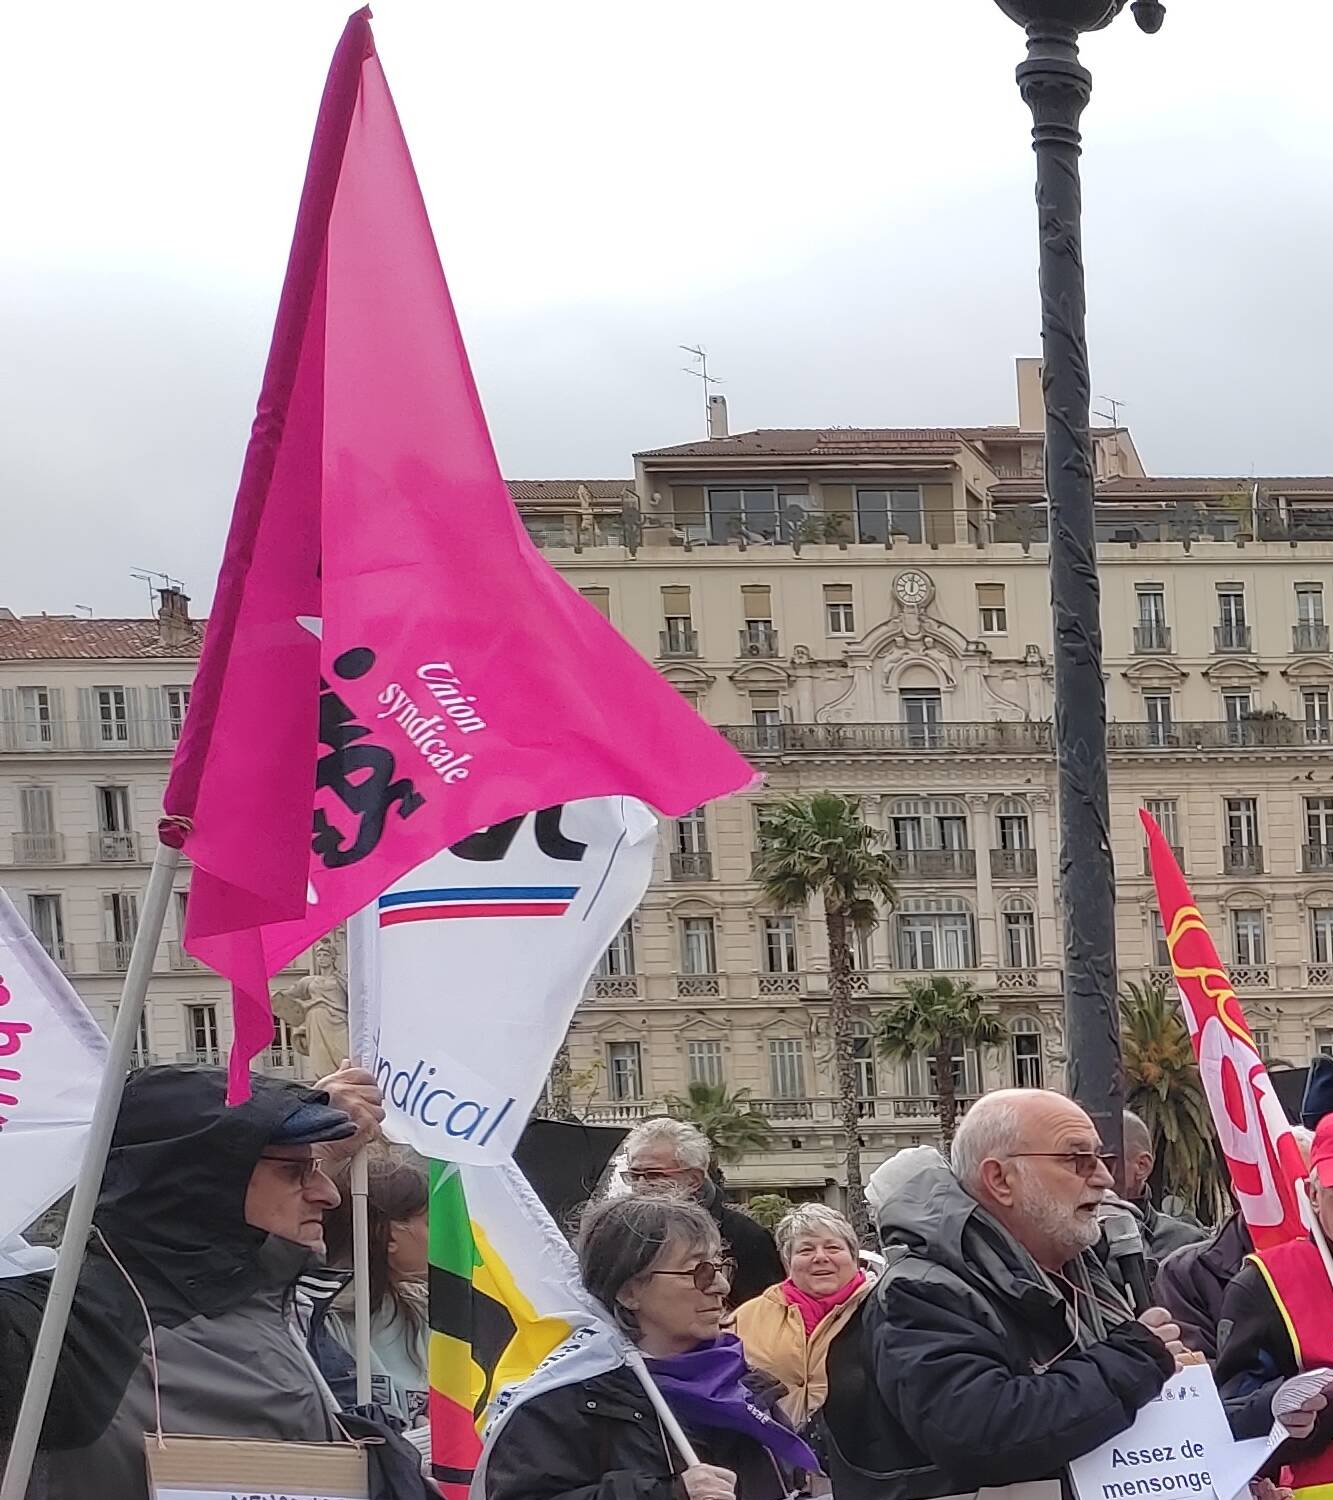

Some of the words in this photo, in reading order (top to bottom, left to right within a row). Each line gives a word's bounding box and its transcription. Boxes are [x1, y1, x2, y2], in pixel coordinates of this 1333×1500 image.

[376, 682, 473, 785] syndicale
[416, 661, 487, 734] Union
[373, 1045, 517, 1147] ndical
[1102, 1469, 1212, 1500] mensonge
[1111, 1447, 1177, 1469] Assez
[1180, 1439, 1205, 1460] de
